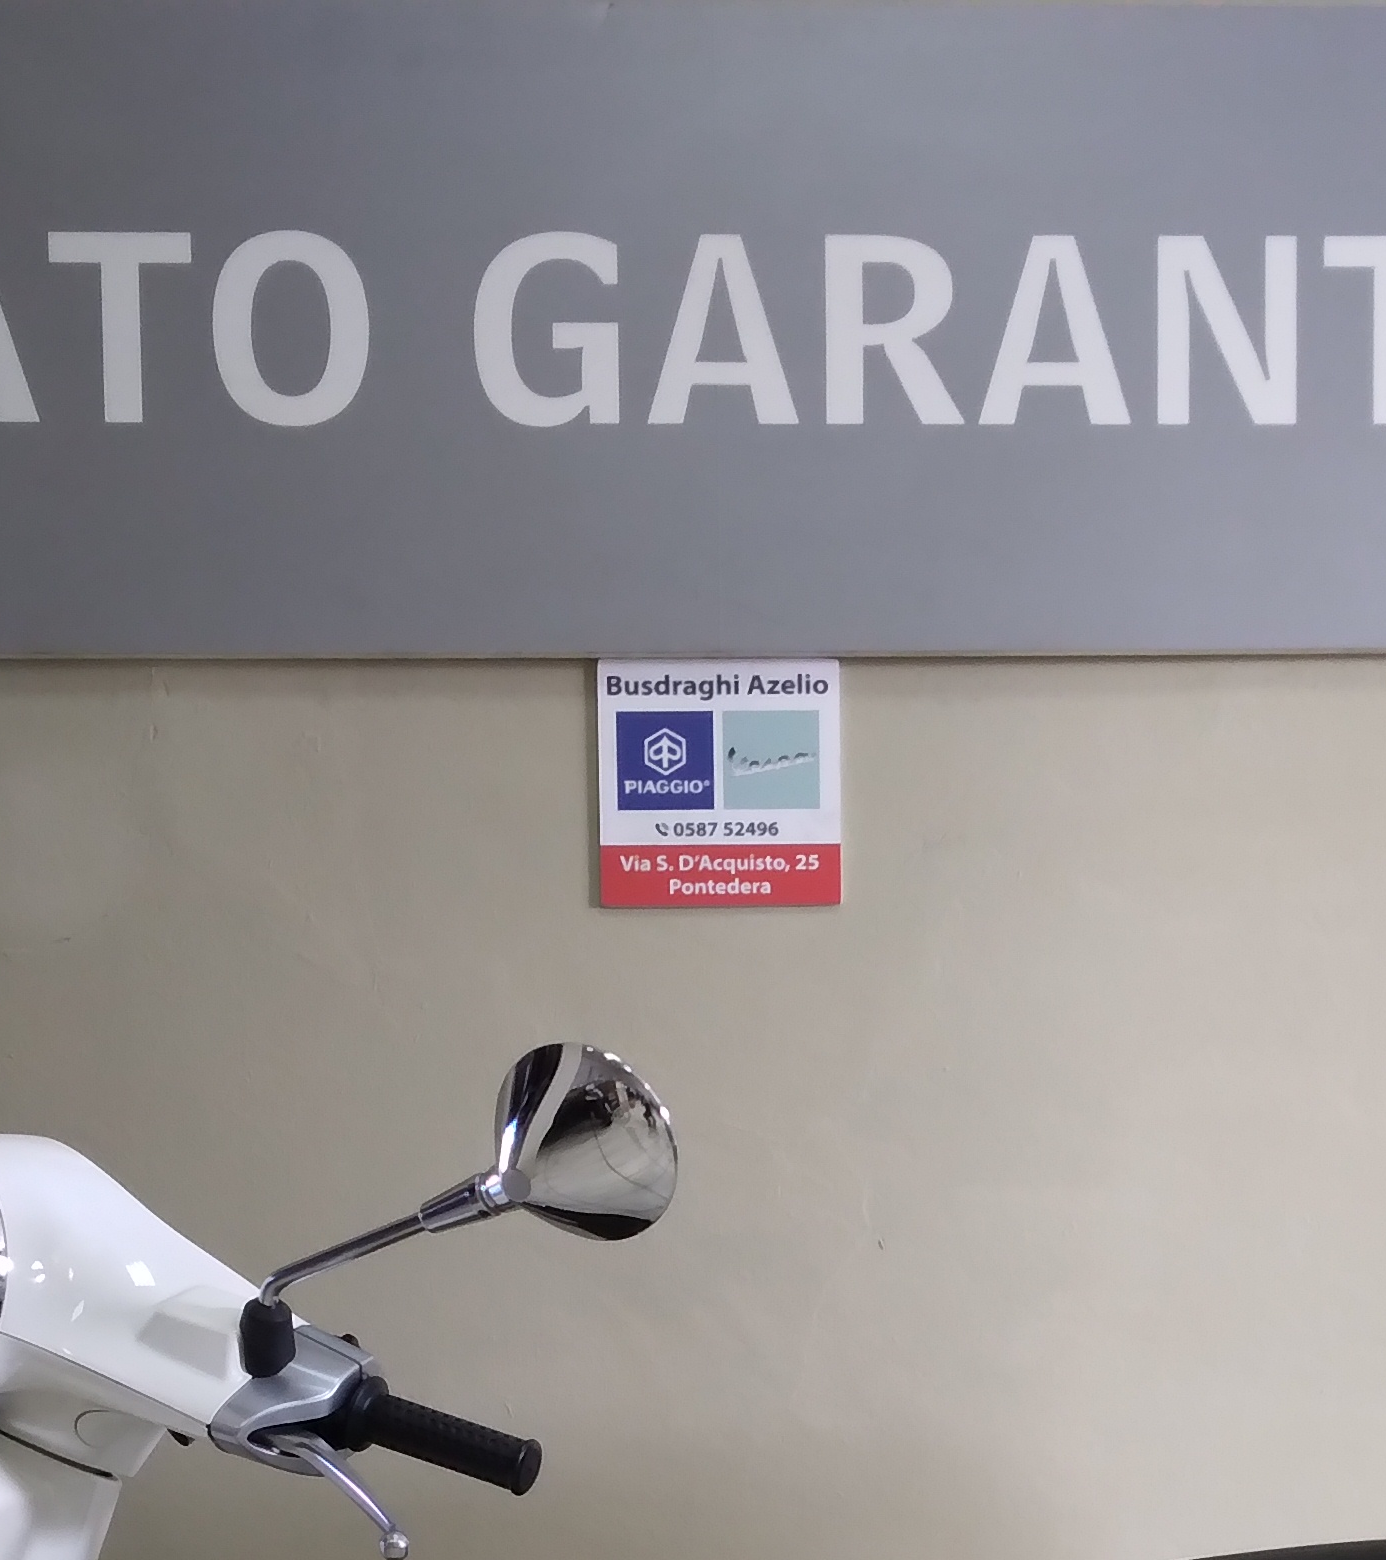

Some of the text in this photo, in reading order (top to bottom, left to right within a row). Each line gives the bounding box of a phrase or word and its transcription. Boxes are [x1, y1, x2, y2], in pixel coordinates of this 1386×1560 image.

[606, 674, 829, 700] Busdraghi Azelio
[673, 822, 779, 836] 0587 52496
[620, 856, 651, 871] Via
[656, 856, 674, 871] S.
[795, 855, 819, 870] 25
[669, 879, 771, 894] Pontedera
